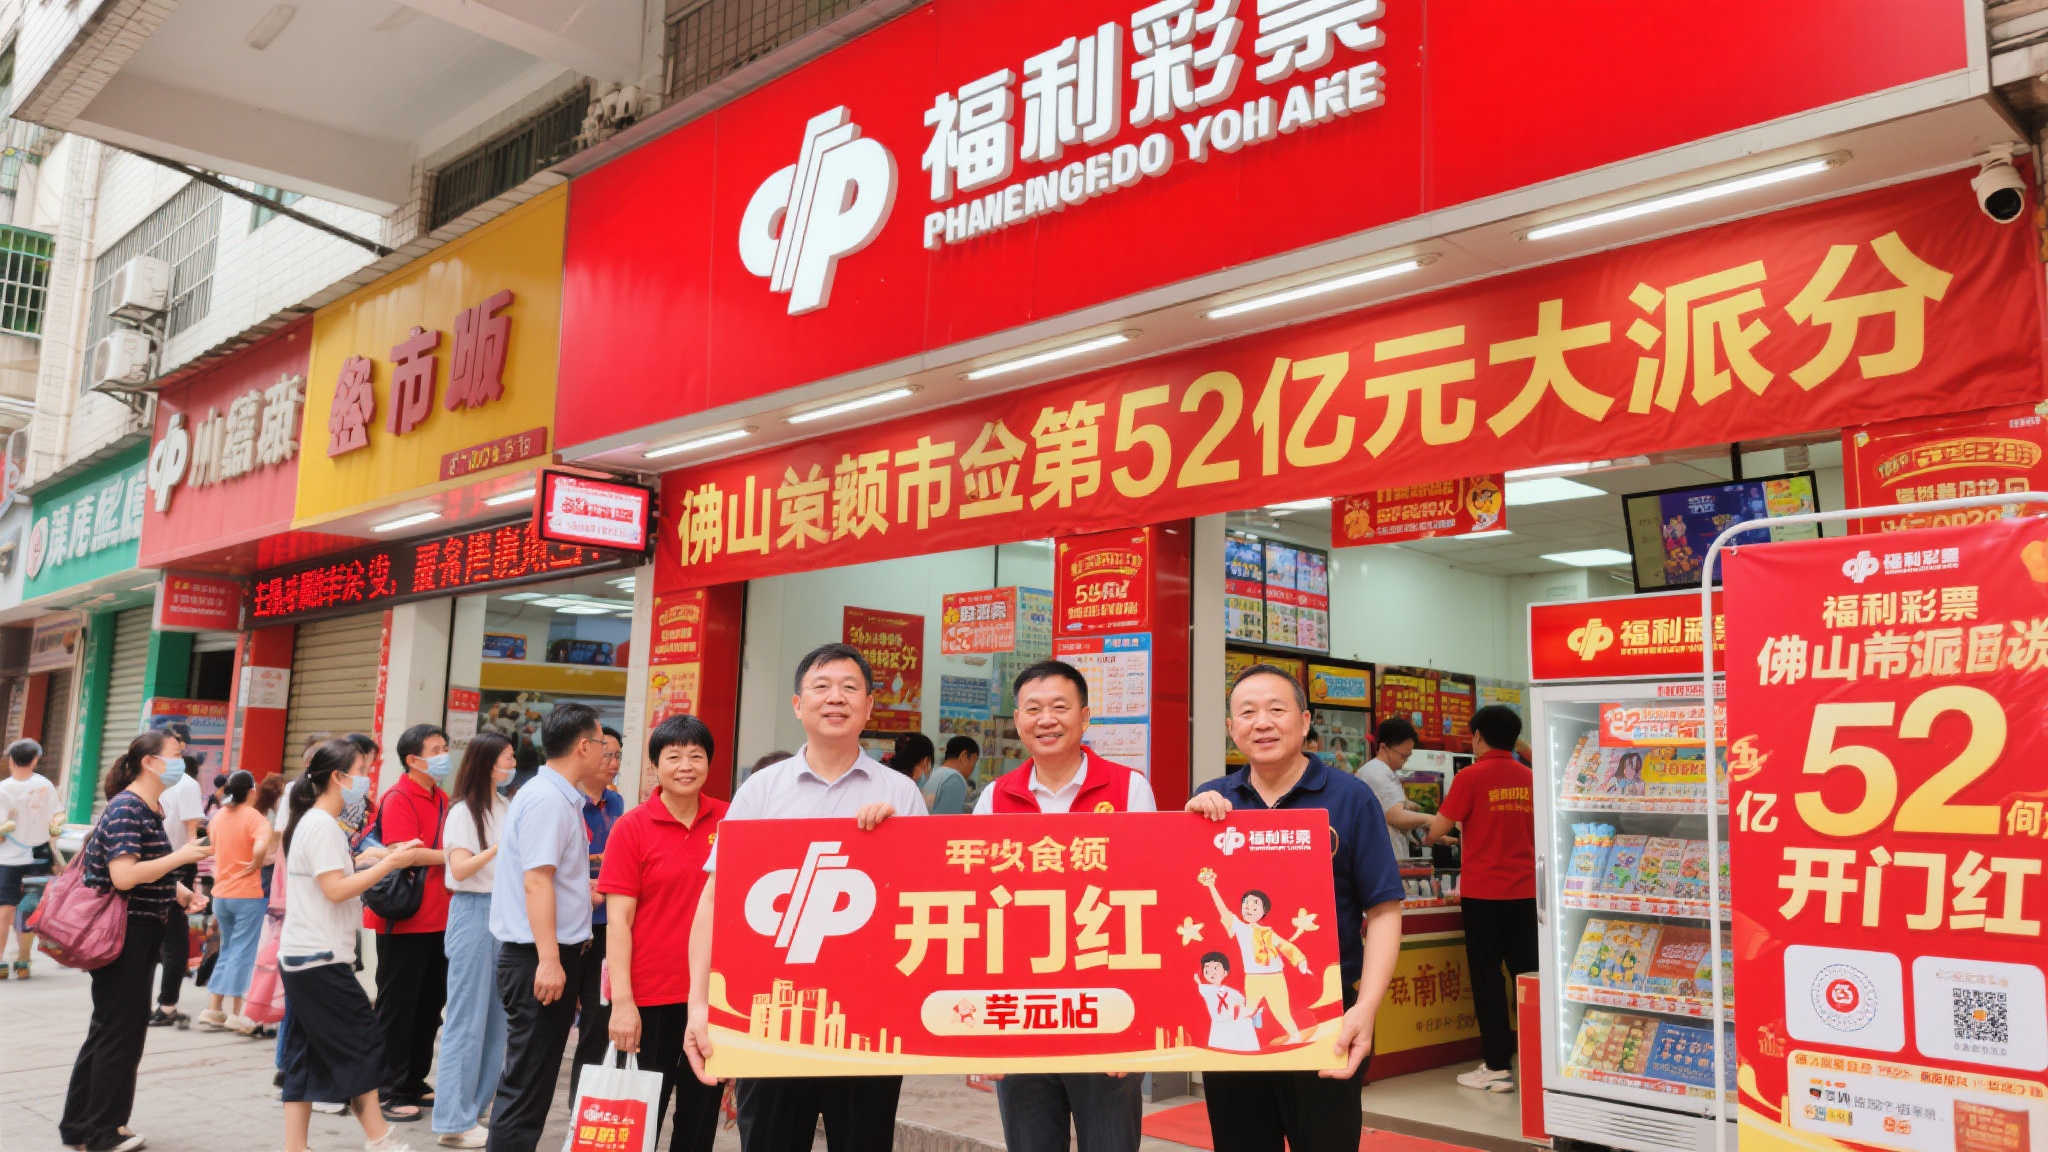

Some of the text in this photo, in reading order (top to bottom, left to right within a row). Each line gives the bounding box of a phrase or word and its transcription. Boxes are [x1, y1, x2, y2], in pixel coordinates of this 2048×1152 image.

[1822, 585, 1979, 629] 福利彩票
[1736, 789, 1779, 833] 亿
[1794, 684, 2008, 837] 52
[895, 884, 1162, 976] 开门红
[1777, 845, 2042, 937] 开门红
